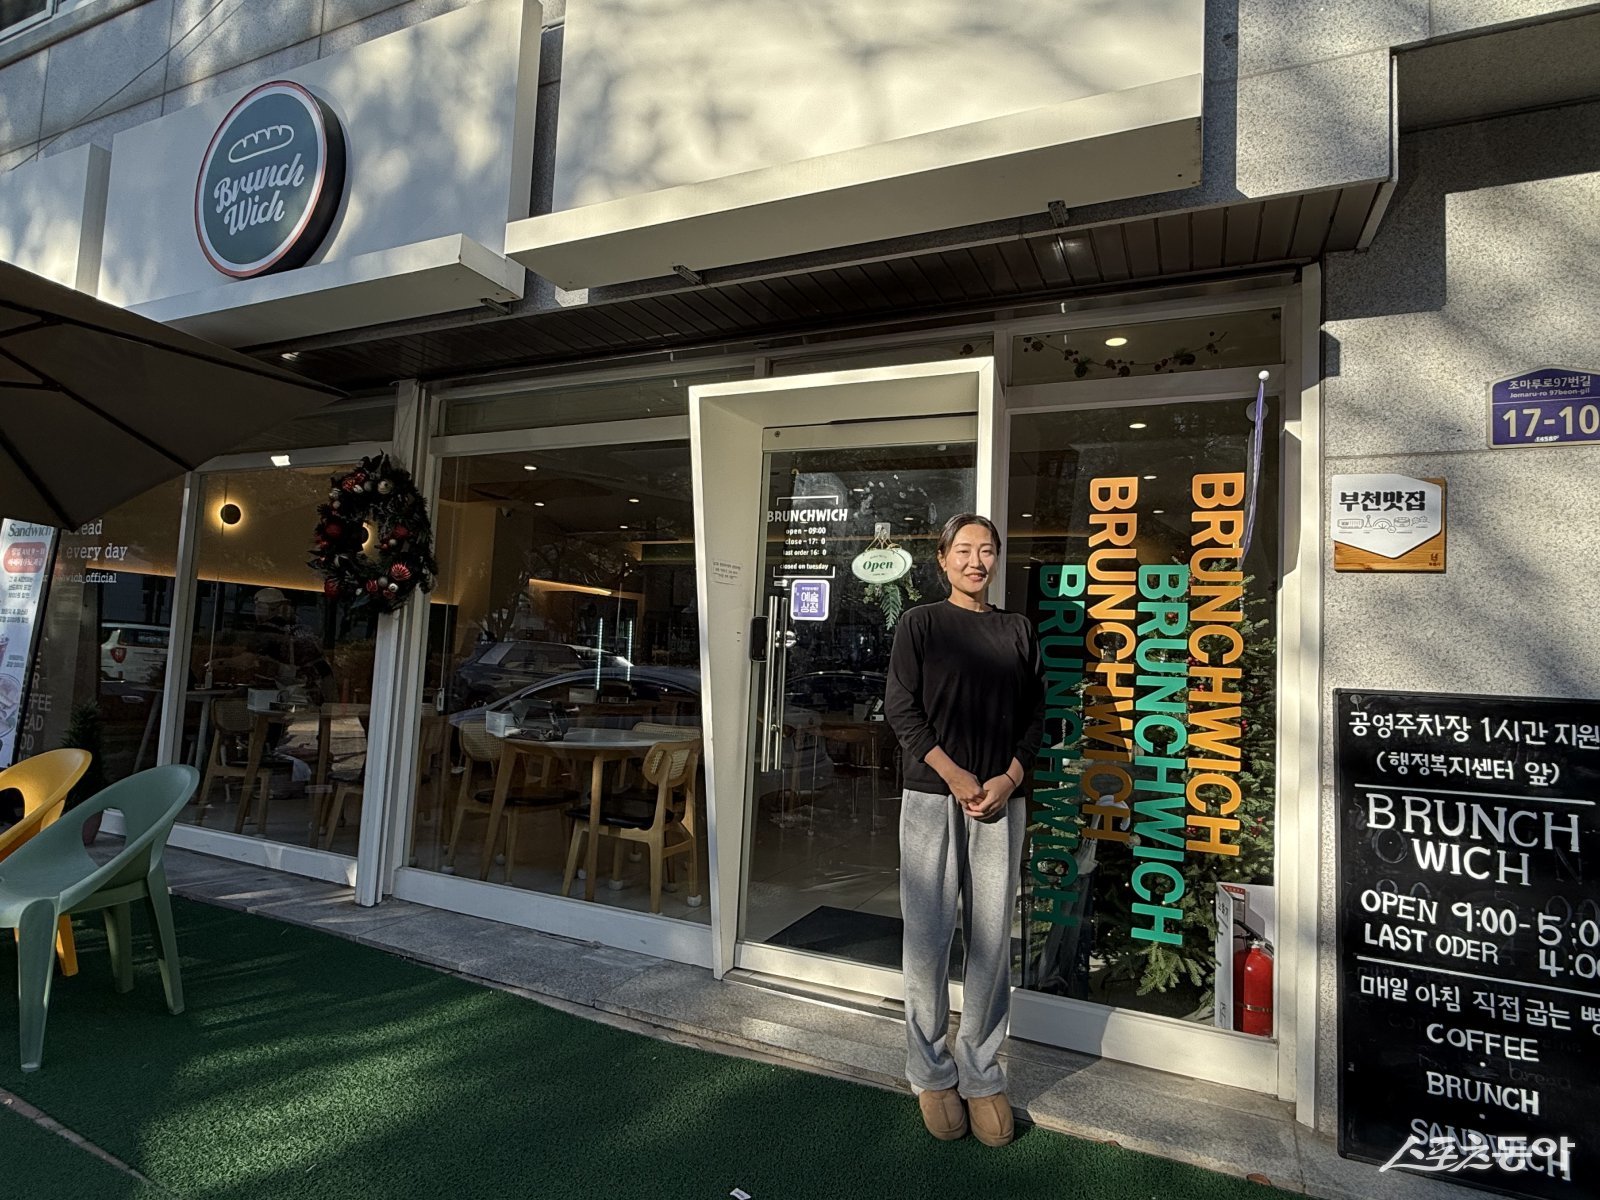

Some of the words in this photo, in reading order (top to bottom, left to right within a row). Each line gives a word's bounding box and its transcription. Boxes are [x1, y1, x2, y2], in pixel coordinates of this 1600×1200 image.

[214, 153, 304, 214] Brunch
[224, 190, 285, 236] Wich
[1508, 375, 1591, 390] 조마루로97번길
[1510, 390, 1548, 398] Jomaru-ro
[1549, 388, 1590, 397] 97beon-gil
[1502, 404, 1600, 437] 17-10
[767, 508, 848, 523] BRUNCHWICH
[1338, 490, 1426, 512] 부천맛집
[786, 528, 802, 536] open
[808, 527, 827, 535] 09:00
[66, 546, 102, 562] every
[104, 542, 129, 562] day
[806, 563, 829, 571] tuesday
[863, 560, 894, 572] Open
[1082, 477, 1138, 842] BRUNCHWICH
[1186, 472, 1245, 856] BRUNCHWICH
[1029, 565, 1086, 926] BRUNCHWICH
[1349, 711, 1472, 743] 공영주차장
[1480, 716, 1549, 746] 1시간
[1554, 723, 1600, 750] 지원
[1131, 564, 1189, 945] BRUNCHWICH
[1376, 751, 1514, 780] (행정복지센터
[1525, 762, 1561, 787] 앞)
[1365, 792, 1580, 853] BRUNCH
[1410, 838, 1532, 887] WICH
[1361, 889, 1439, 925] OPEN
[1364, 922, 1428, 953] LAST
[1435, 934, 1500, 965] ODER
[1539, 949, 1600, 979] 4:0
[1361, 975, 1408, 1002] 매일
[1415, 983, 1461, 1013] 아침
[1472, 991, 1520, 1023] 직접
[1525, 998, 1571, 1032] 굽는
[1426, 1023, 1540, 1063] COFFEE
[1426, 1071, 1540, 1116] BRUNCH
